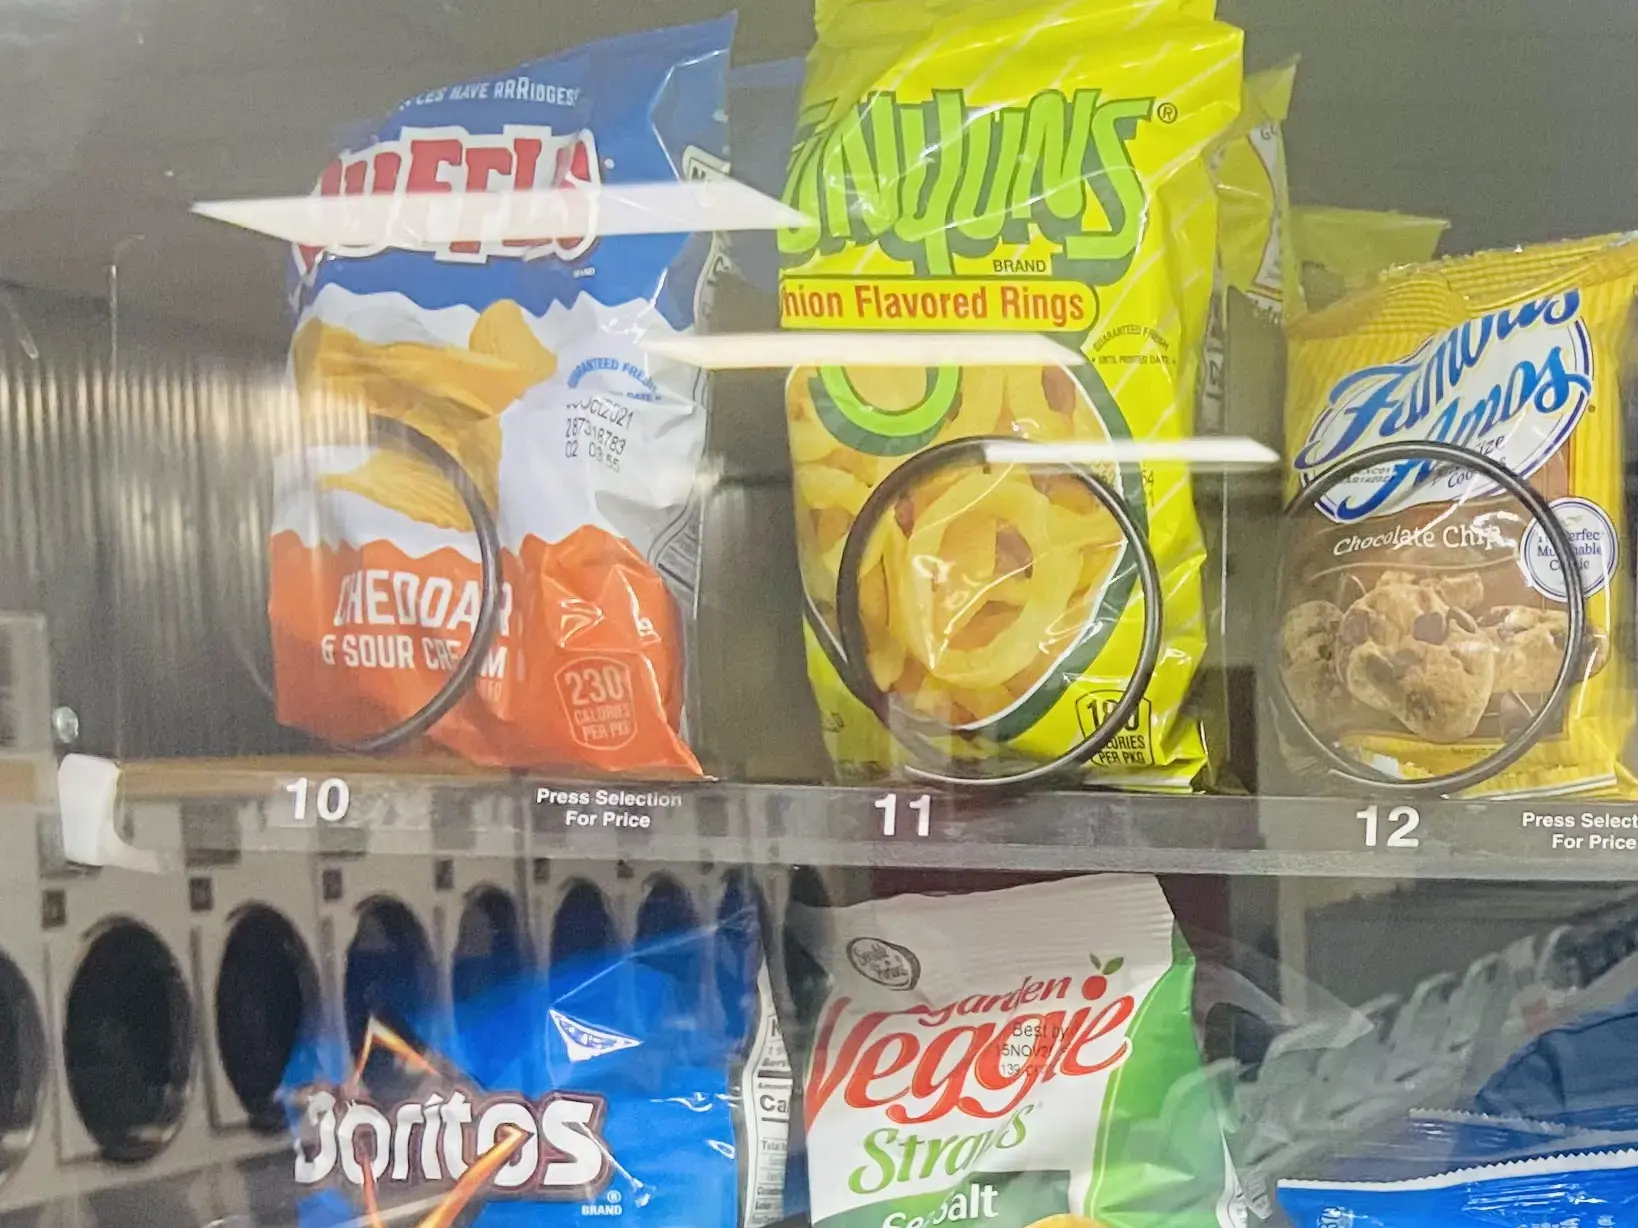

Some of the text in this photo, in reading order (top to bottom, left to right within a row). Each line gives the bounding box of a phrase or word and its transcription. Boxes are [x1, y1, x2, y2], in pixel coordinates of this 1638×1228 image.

[992, 259, 1047, 274] BRAND
[854, 284, 1085, 328] Flavored Rings
[1333, 524, 1435, 556] Chocolate
[342, 634, 508, 679] SOUR CREM
[564, 665, 625, 706] 230
[573, 703, 631, 725] CALORIES
[286, 778, 350, 821] 10
[536, 788, 683, 808] Press Selection
[564, 810, 651, 829] For Price
[874, 794, 932, 836] 11
[1356, 806, 1420, 848] 12
[1522, 812, 1575, 830] Press
[1551, 833, 1638, 852] For Price
[805, 994, 1136, 1137] Veggie
[581, 1204, 623, 1216] BRAND
